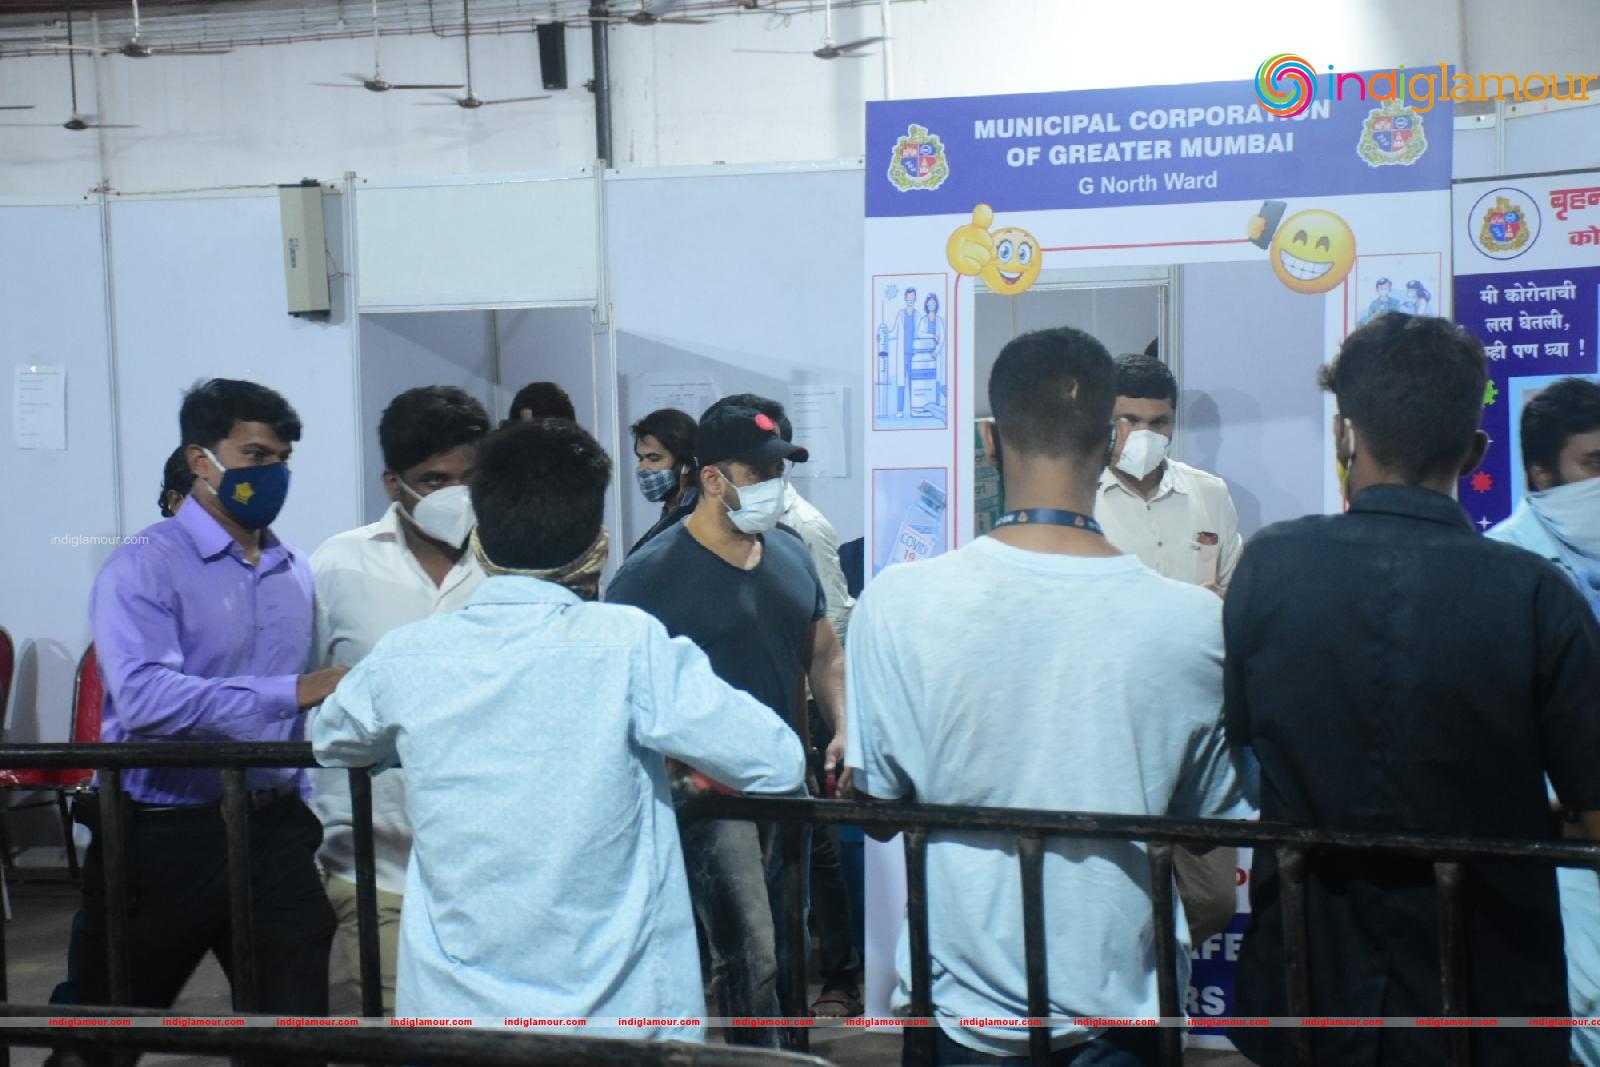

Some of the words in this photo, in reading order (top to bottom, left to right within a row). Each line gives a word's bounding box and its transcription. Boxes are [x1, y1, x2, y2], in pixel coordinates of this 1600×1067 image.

[974, 113, 1122, 140] MUNICIPAL
[1129, 99, 1330, 131] CORPORAN
[1006, 146, 1041, 168] OF
[1048, 139, 1172, 165] GREATER
[1180, 132, 1294, 159] MUMBAI
[1078, 177, 1094, 195] G
[1100, 174, 1158, 194] North
[1163, 171, 1219, 192] Ward
[1479, 284, 1499, 304] मी
[1504, 280, 1577, 303] कोरोनाची
[1484, 317, 1513, 333] लस
[1512, 344, 1540, 358] पण
[1579, 338, 1585, 356] !
